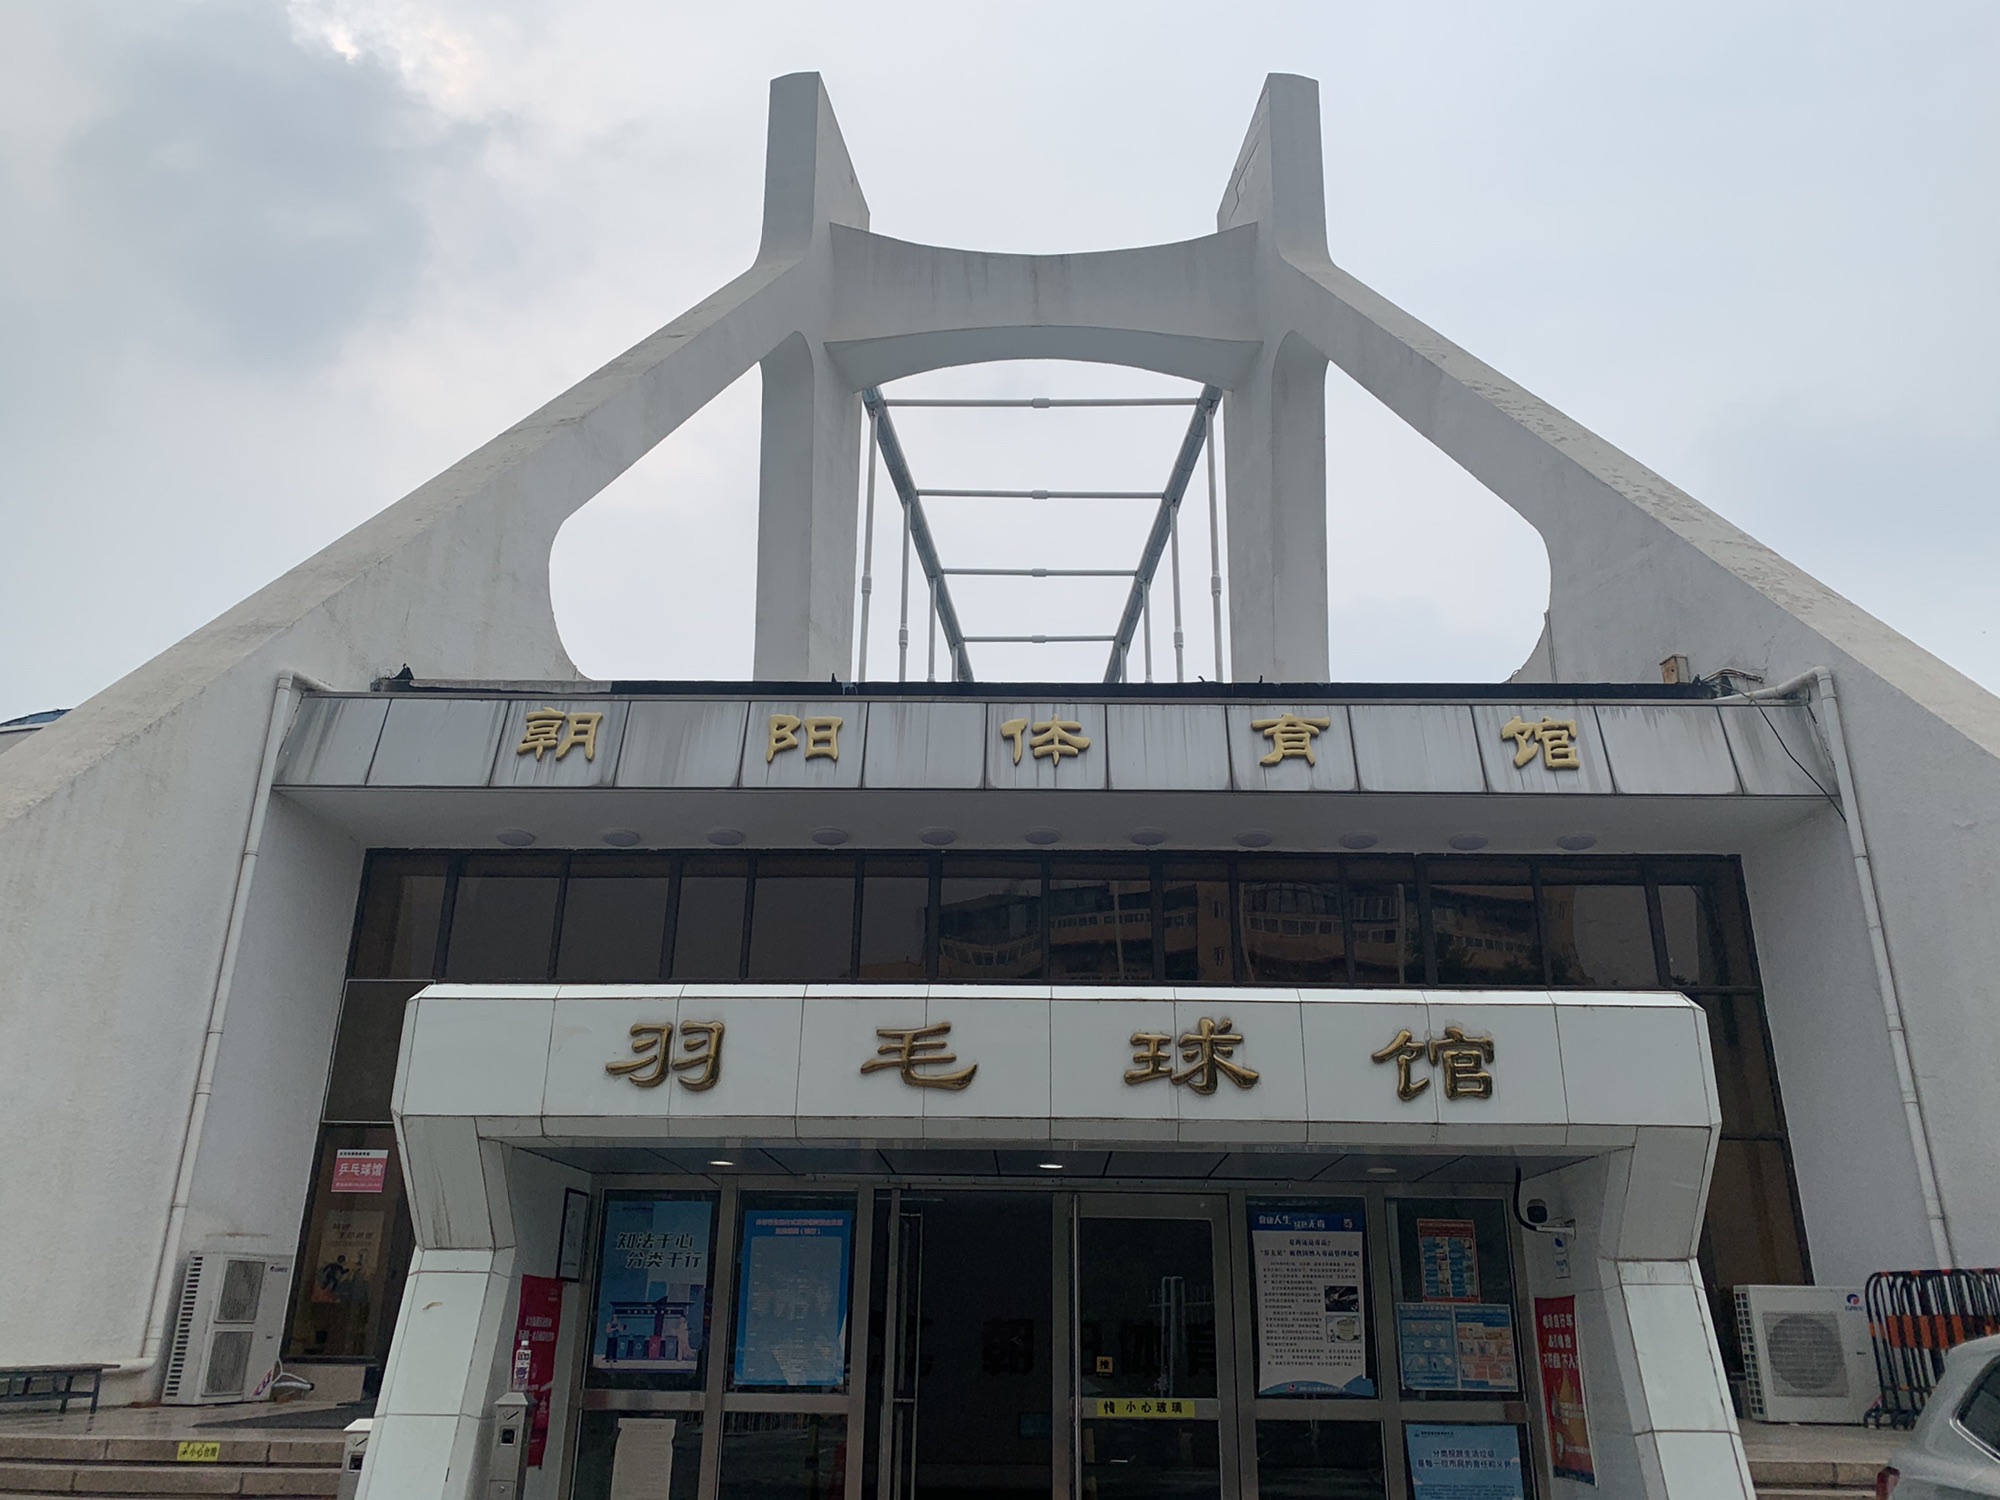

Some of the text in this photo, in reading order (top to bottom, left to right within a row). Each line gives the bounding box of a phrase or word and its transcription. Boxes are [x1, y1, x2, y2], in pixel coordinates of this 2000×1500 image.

[516, 706, 1580, 770] 朝阳体育馆
[605, 1017, 1494, 1100] 羽毛球馆
[338, 1162, 383, 1176] 乒乓球馆
[1258, 1214, 1291, 1225] 健康人生
[1126, 1400, 1182, 1413] 小心玻璃
